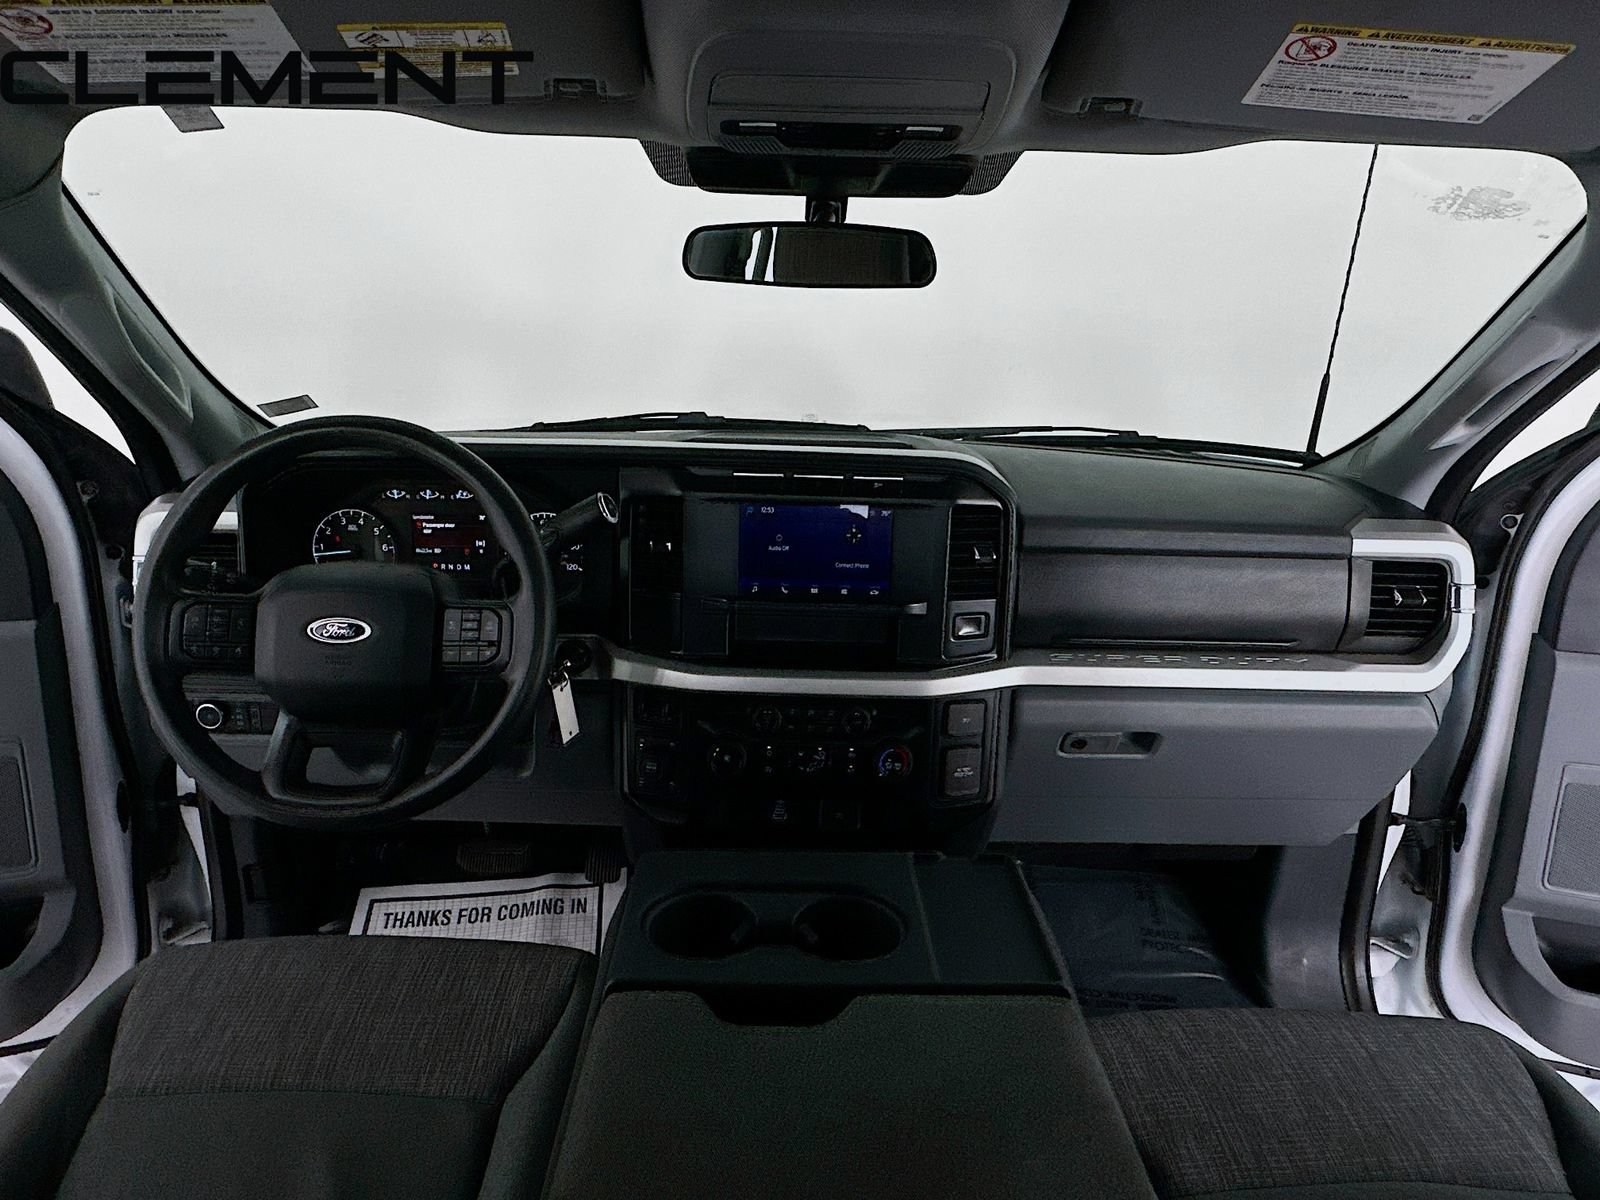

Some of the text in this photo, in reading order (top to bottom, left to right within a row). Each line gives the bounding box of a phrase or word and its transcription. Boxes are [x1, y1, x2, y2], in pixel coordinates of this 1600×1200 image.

[1309, 26, 1361, 37] WARNING
[340, 517, 346, 525] 3
[325, 527, 332, 535] 2
[373, 527, 380, 535] 5
[382, 543, 389, 551] 6
[322, 622, 355, 637] Ford
[383, 897, 588, 929] THANKS FOR COMING IN
